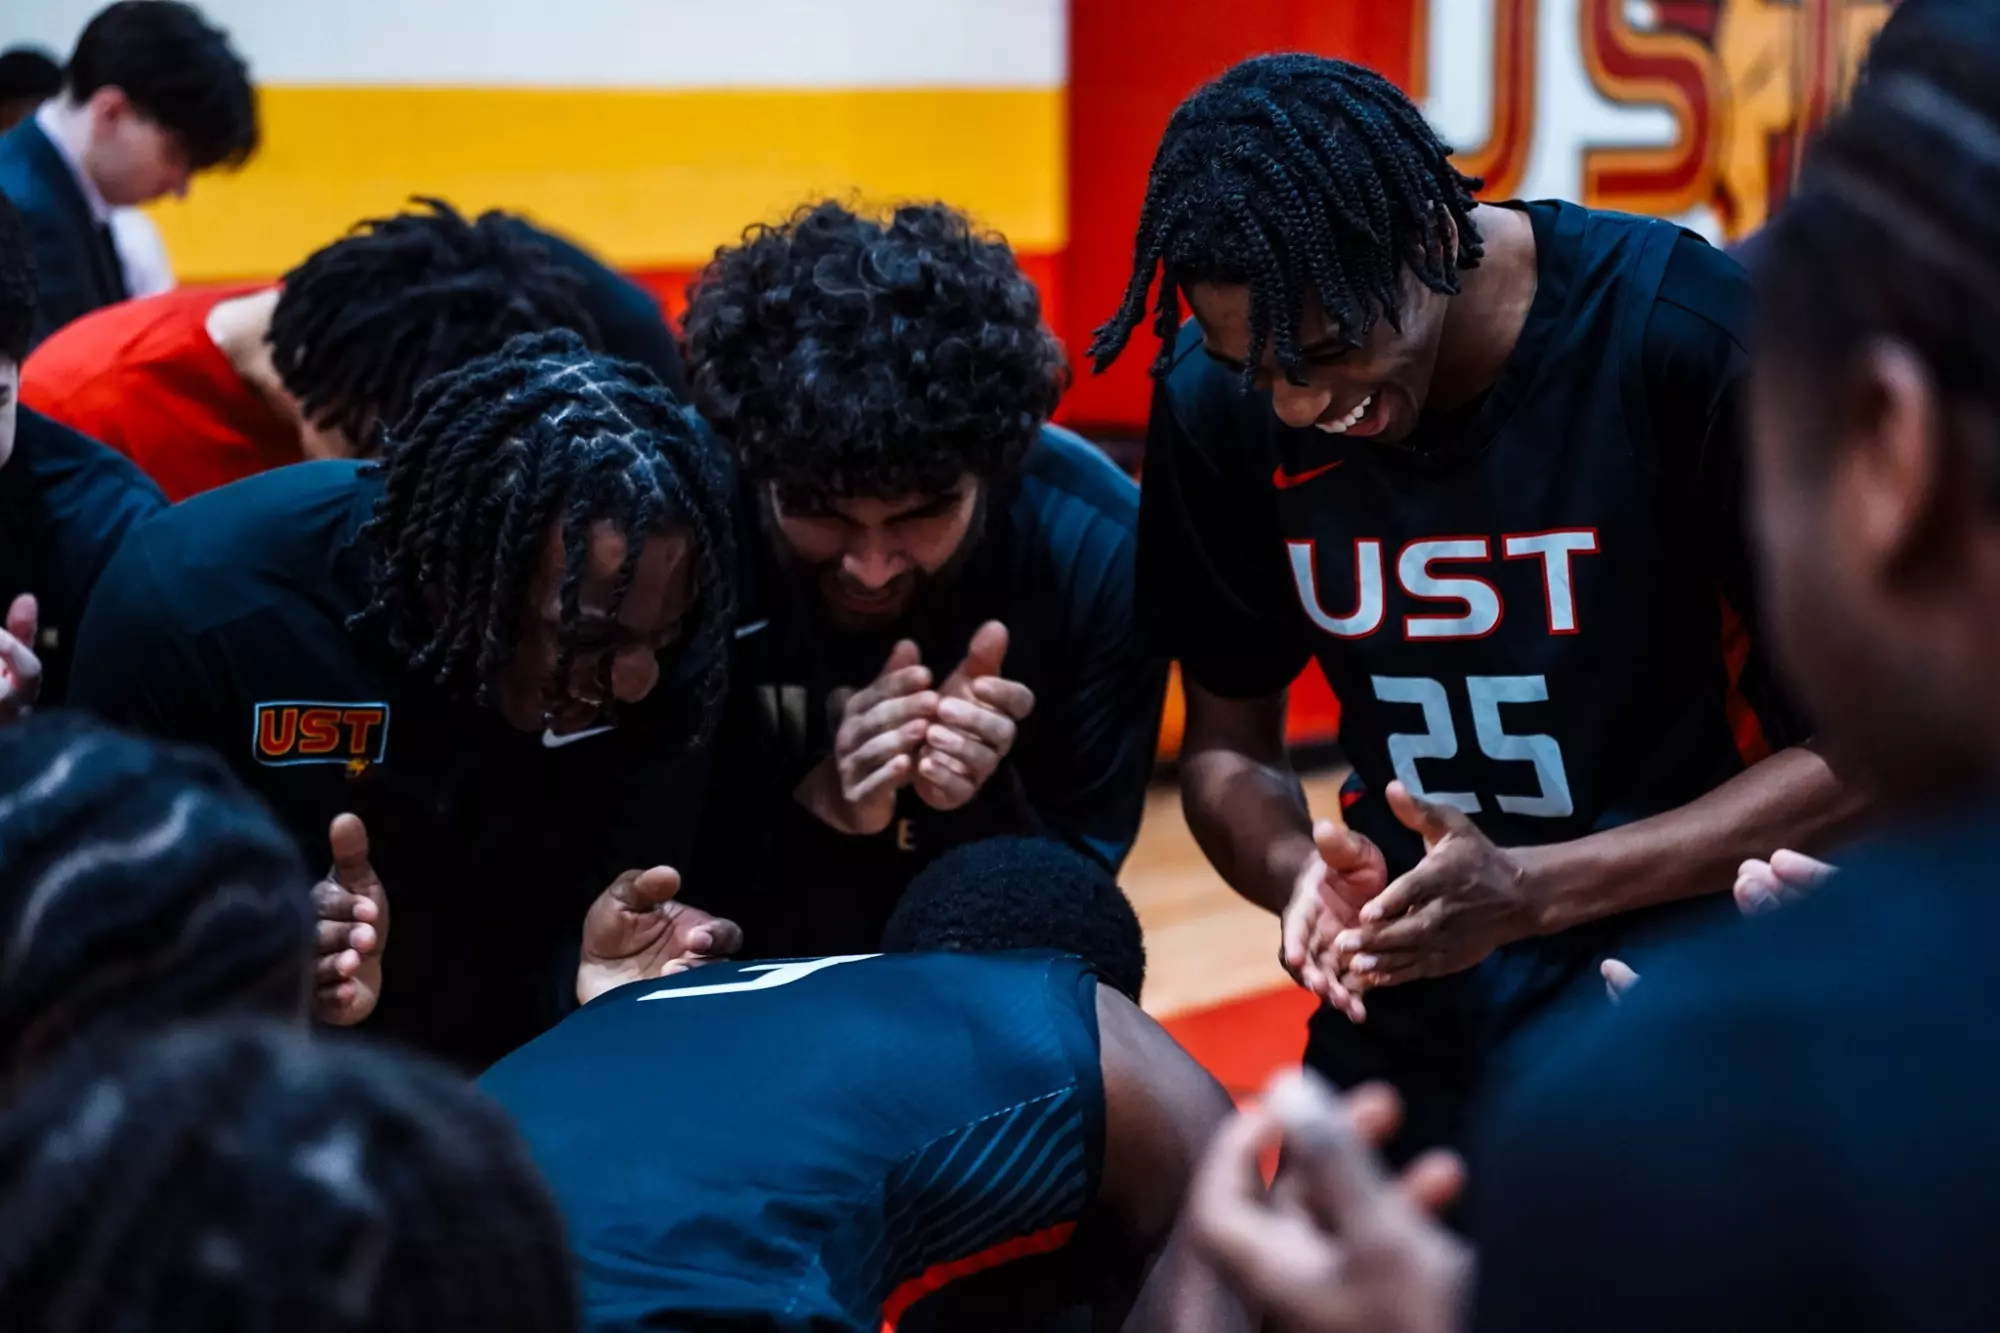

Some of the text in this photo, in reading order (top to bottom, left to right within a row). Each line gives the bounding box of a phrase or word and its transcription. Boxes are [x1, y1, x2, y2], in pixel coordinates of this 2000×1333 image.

[1284, 527, 1600, 642] UST
[260, 707, 384, 756] UST
[1370, 674, 1574, 818] 25
